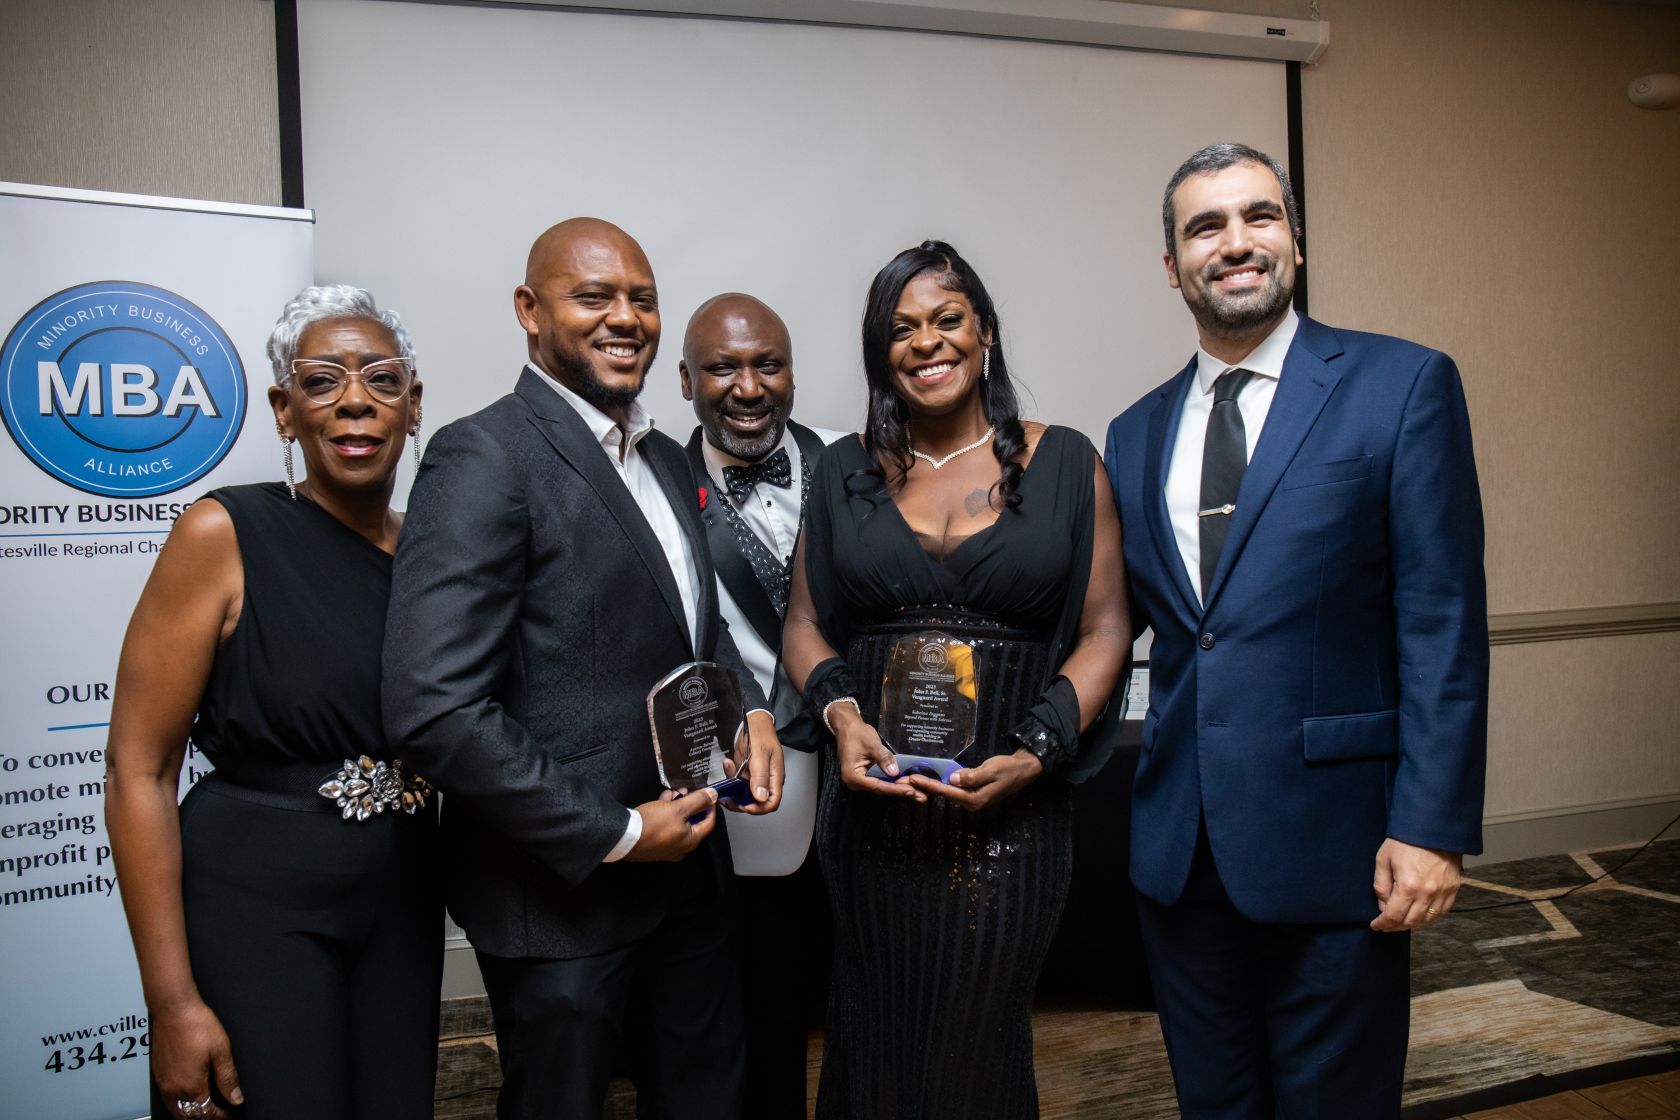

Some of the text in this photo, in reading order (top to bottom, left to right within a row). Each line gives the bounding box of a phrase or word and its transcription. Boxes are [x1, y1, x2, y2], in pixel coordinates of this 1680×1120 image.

[37, 304, 209, 356] MINORITY BUSINESS
[37, 360, 222, 418] MBA
[84, 457, 173, 477] ALLIANCE
[63, 541, 133, 558] Regional
[922, 653, 945, 663] MBA
[47, 683, 110, 704] OUR
[0, 754, 19, 772] o
[28, 749, 108, 769] conve
[0, 783, 70, 805] mote
[1, 812, 96, 839] eraging
[0, 874, 117, 906] mmunity
[41, 1015, 148, 1046] www.cville
